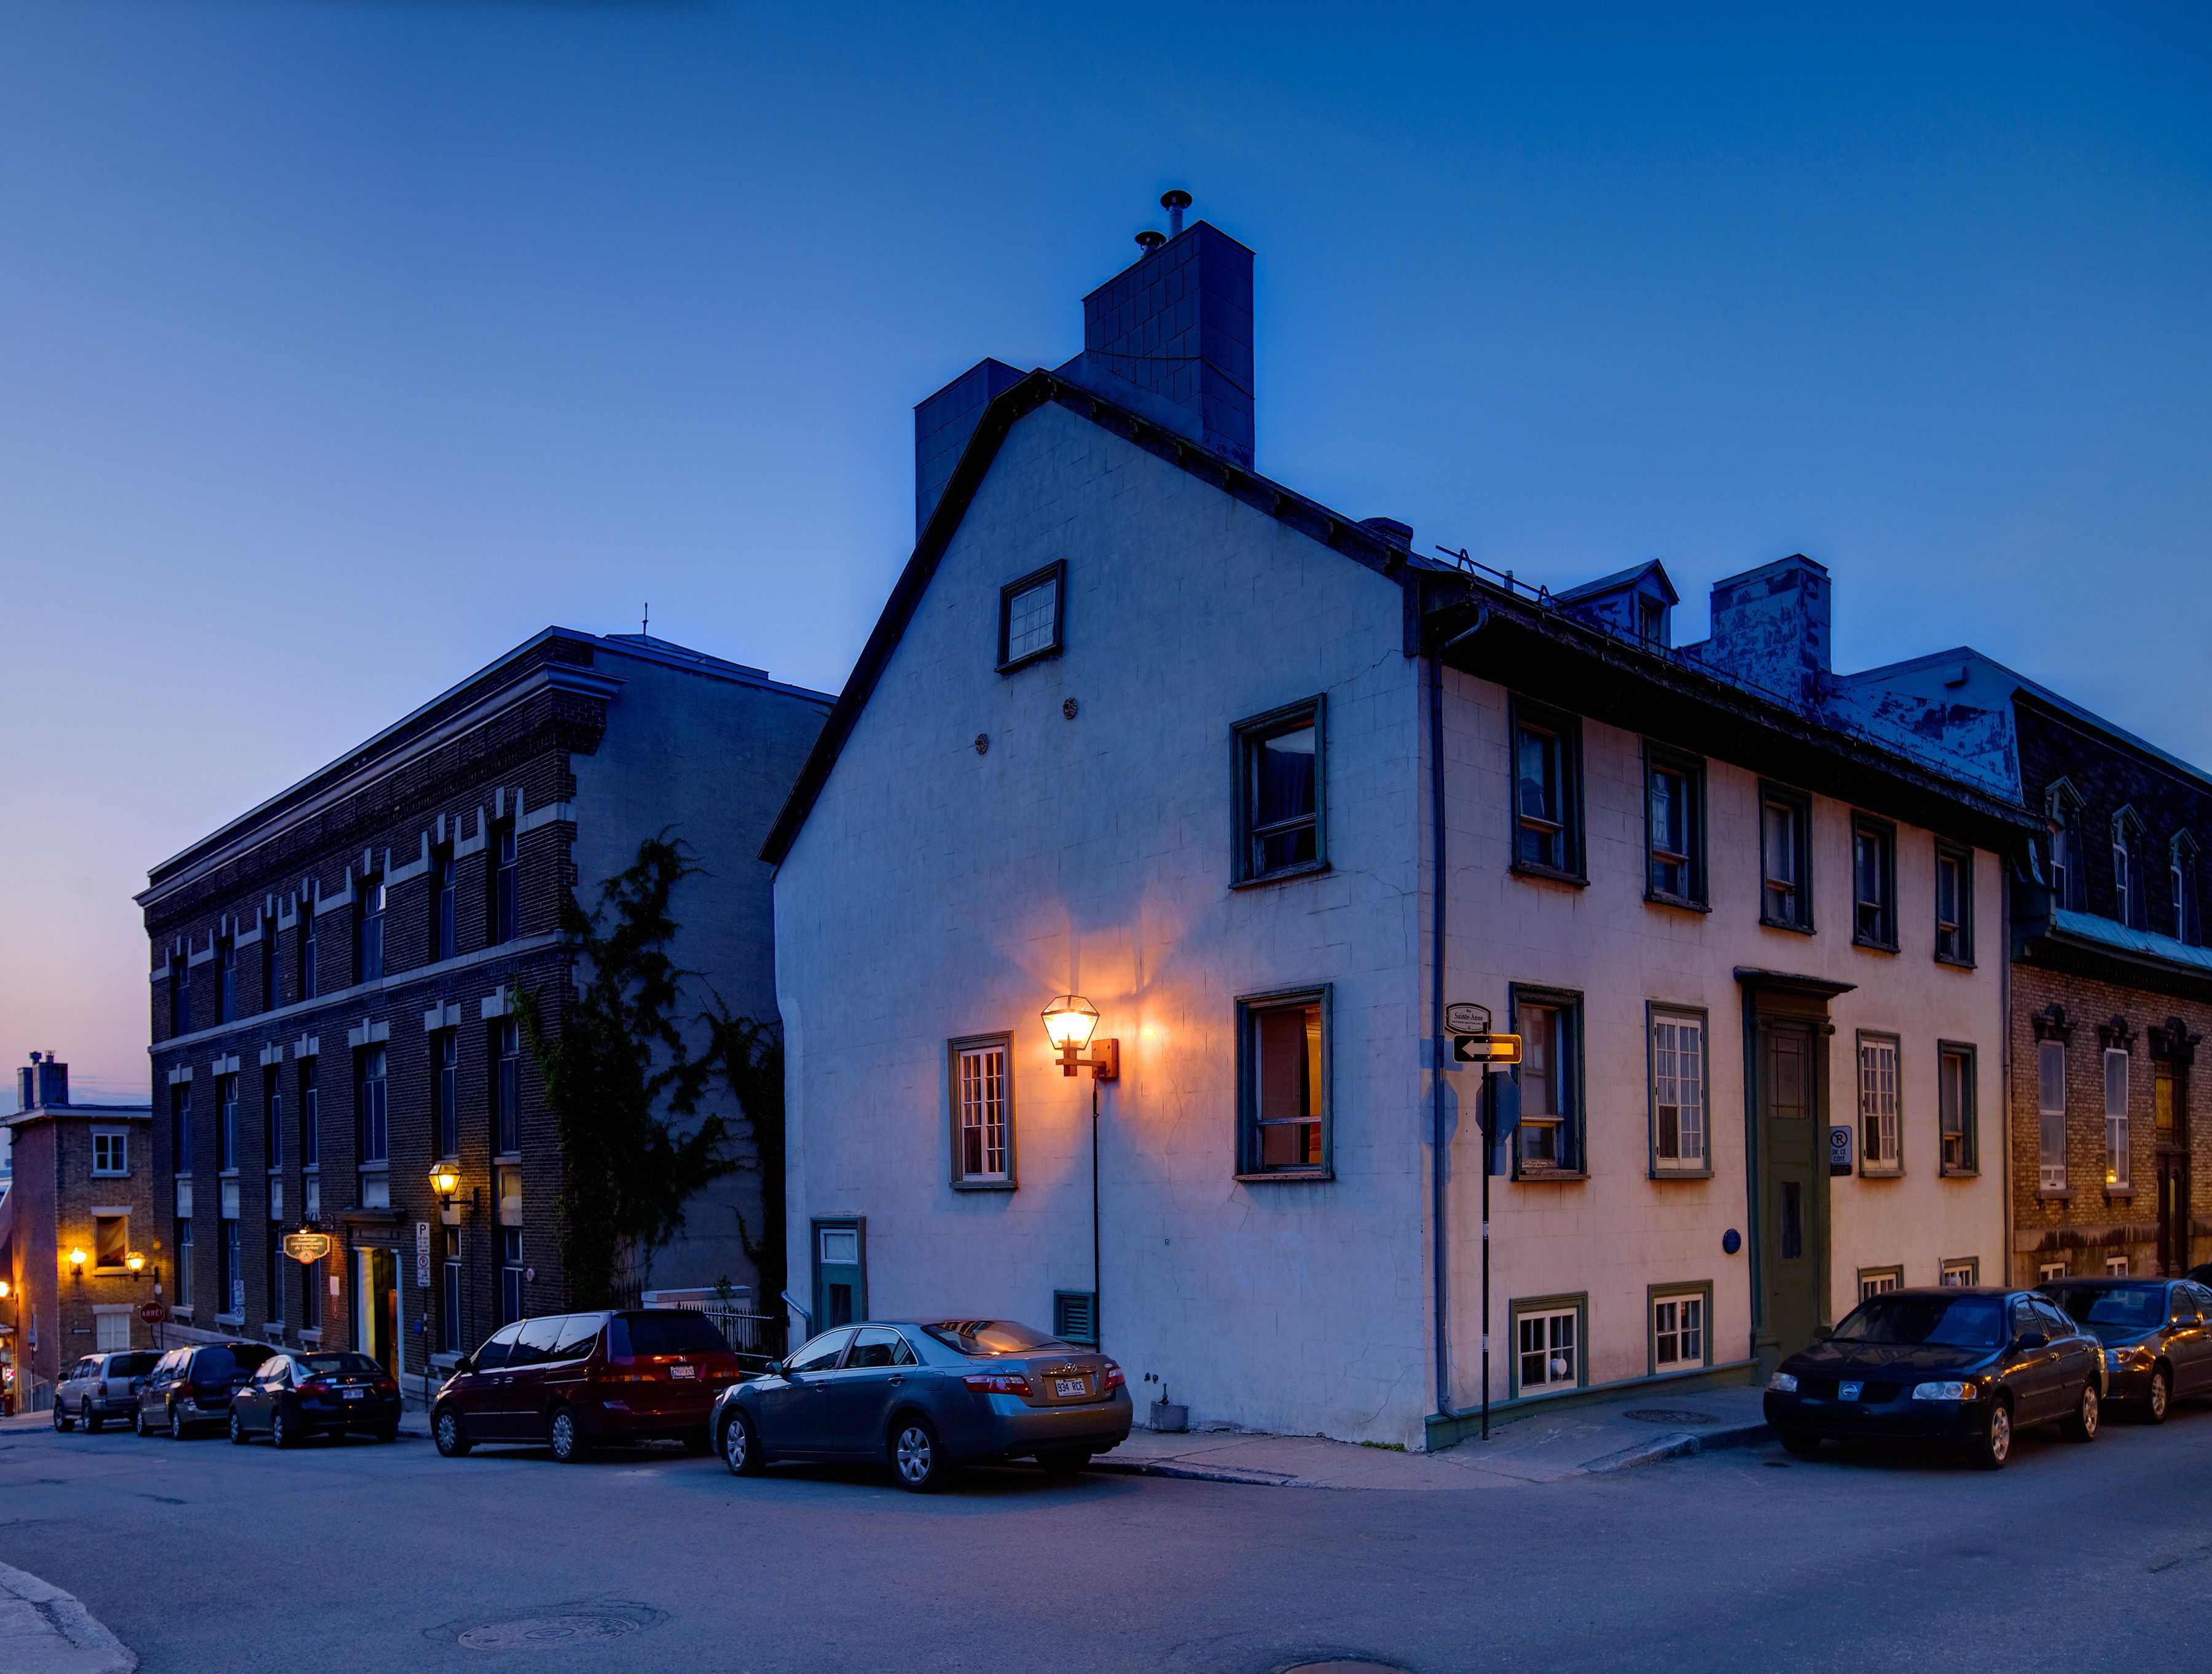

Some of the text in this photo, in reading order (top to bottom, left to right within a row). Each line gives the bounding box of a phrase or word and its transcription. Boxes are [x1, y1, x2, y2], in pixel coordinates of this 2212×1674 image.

[1454, 1012, 1483, 1021] Sainte-Anne
[420, 1224, 426, 1234] P
[1057, 1381, 1084, 1392] 934 RCE
